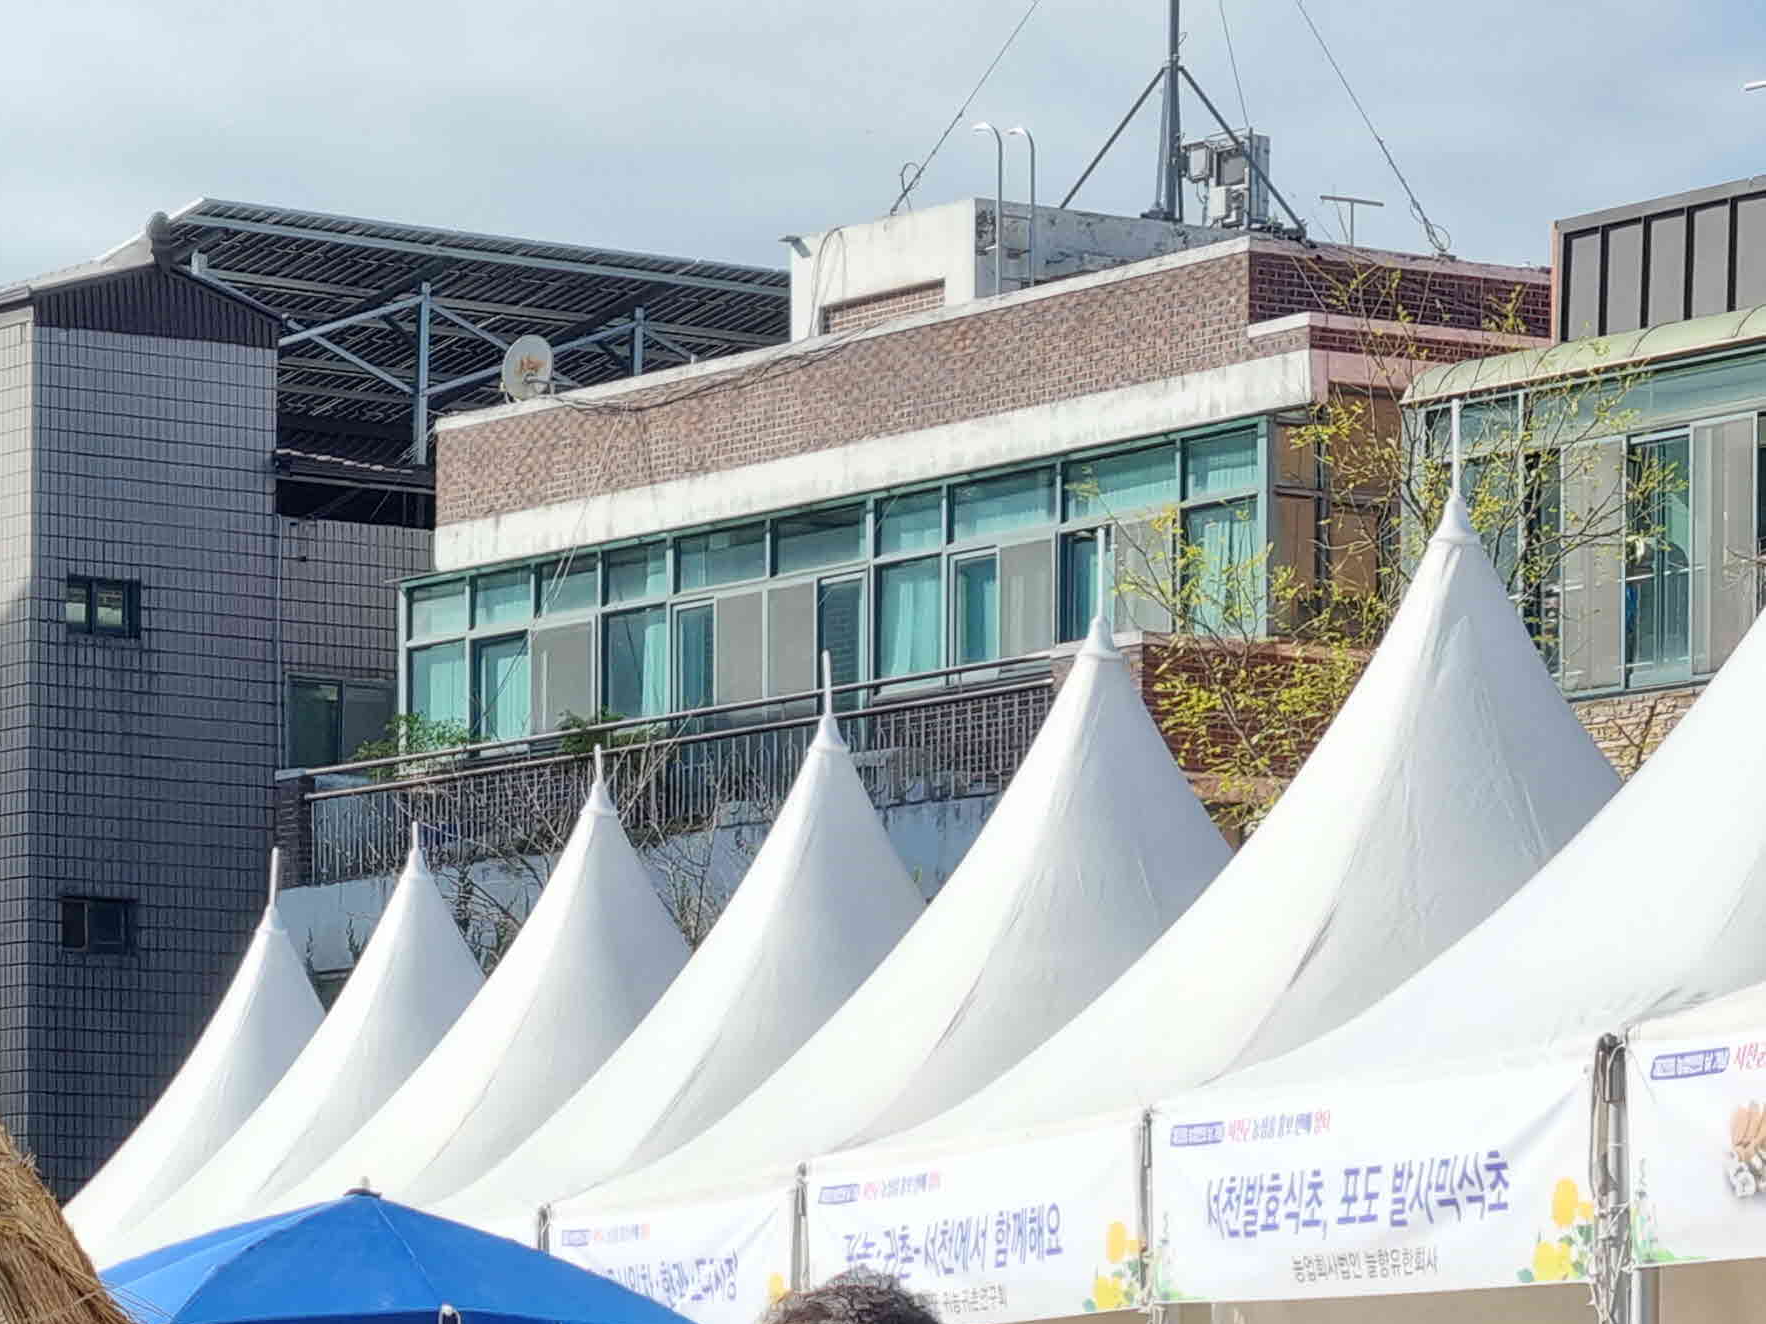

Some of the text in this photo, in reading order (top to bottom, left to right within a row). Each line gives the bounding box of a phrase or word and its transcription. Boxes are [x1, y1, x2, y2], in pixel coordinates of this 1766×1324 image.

[1207, 1150, 1509, 1240] 서천발효식초, 포도 발사믹식초
[994, 1203, 1063, 1268] 함께해요
